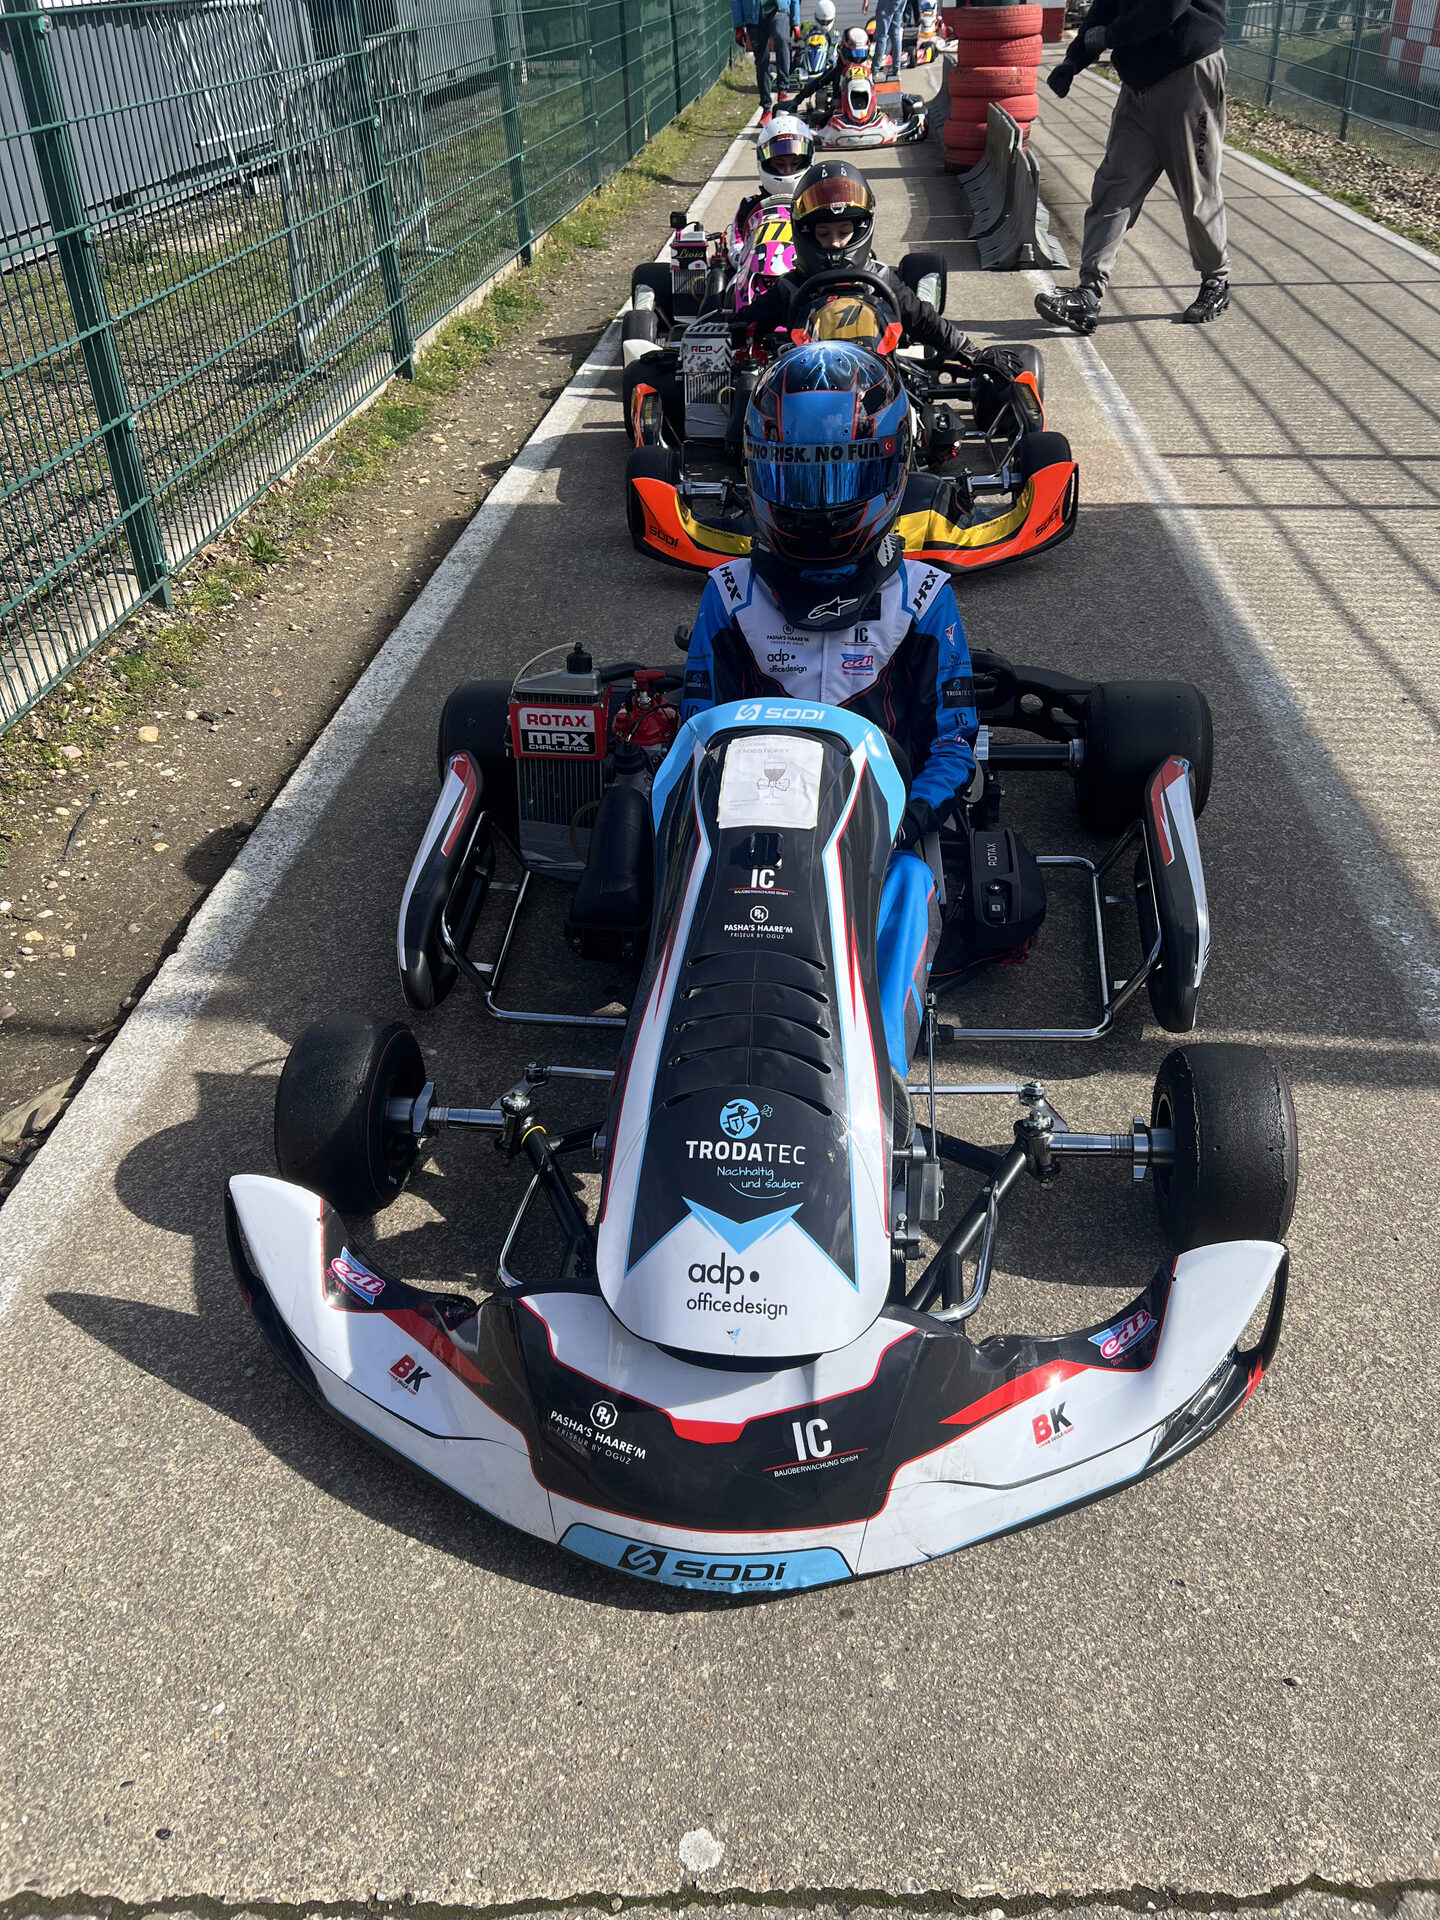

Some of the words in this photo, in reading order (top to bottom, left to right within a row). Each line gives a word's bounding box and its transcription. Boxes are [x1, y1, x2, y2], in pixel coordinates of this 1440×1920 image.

[756, 221, 792, 244] 77
[752, 445, 768, 460] NO
[770, 446, 810, 463] RISK.
[815, 446, 843, 463] NO
[649, 525, 679, 548] SODI
[719, 566, 743, 602] HRX
[912, 569, 939, 610] HRX
[855, 627, 868, 643] IC
[526, 713, 587, 728] ROTAX
[953, 712, 968, 727] IC
[986, 843, 998, 867] ROTAX
[751, 869, 775, 888] IC
[686, 1140, 806, 1165] TRODATEC
[717, 1166, 774, 1182] Nachhaltig
[741, 1178, 761, 1189] und
[765, 1179, 804, 1190] sauber
[331, 1257, 386, 1296] edi
[1101, 1309, 1151, 1359] edi
[390, 1354, 432, 1393] BK
[1032, 1400, 1073, 1445] BK
[556, 1427, 590, 1447] FRISEUR
[591, 1444, 602, 1453] BY
[605, 1450, 632, 1465] OGUZ
[792, 1418, 832, 1461] IC
[840, 1454, 859, 1464] GmbH
